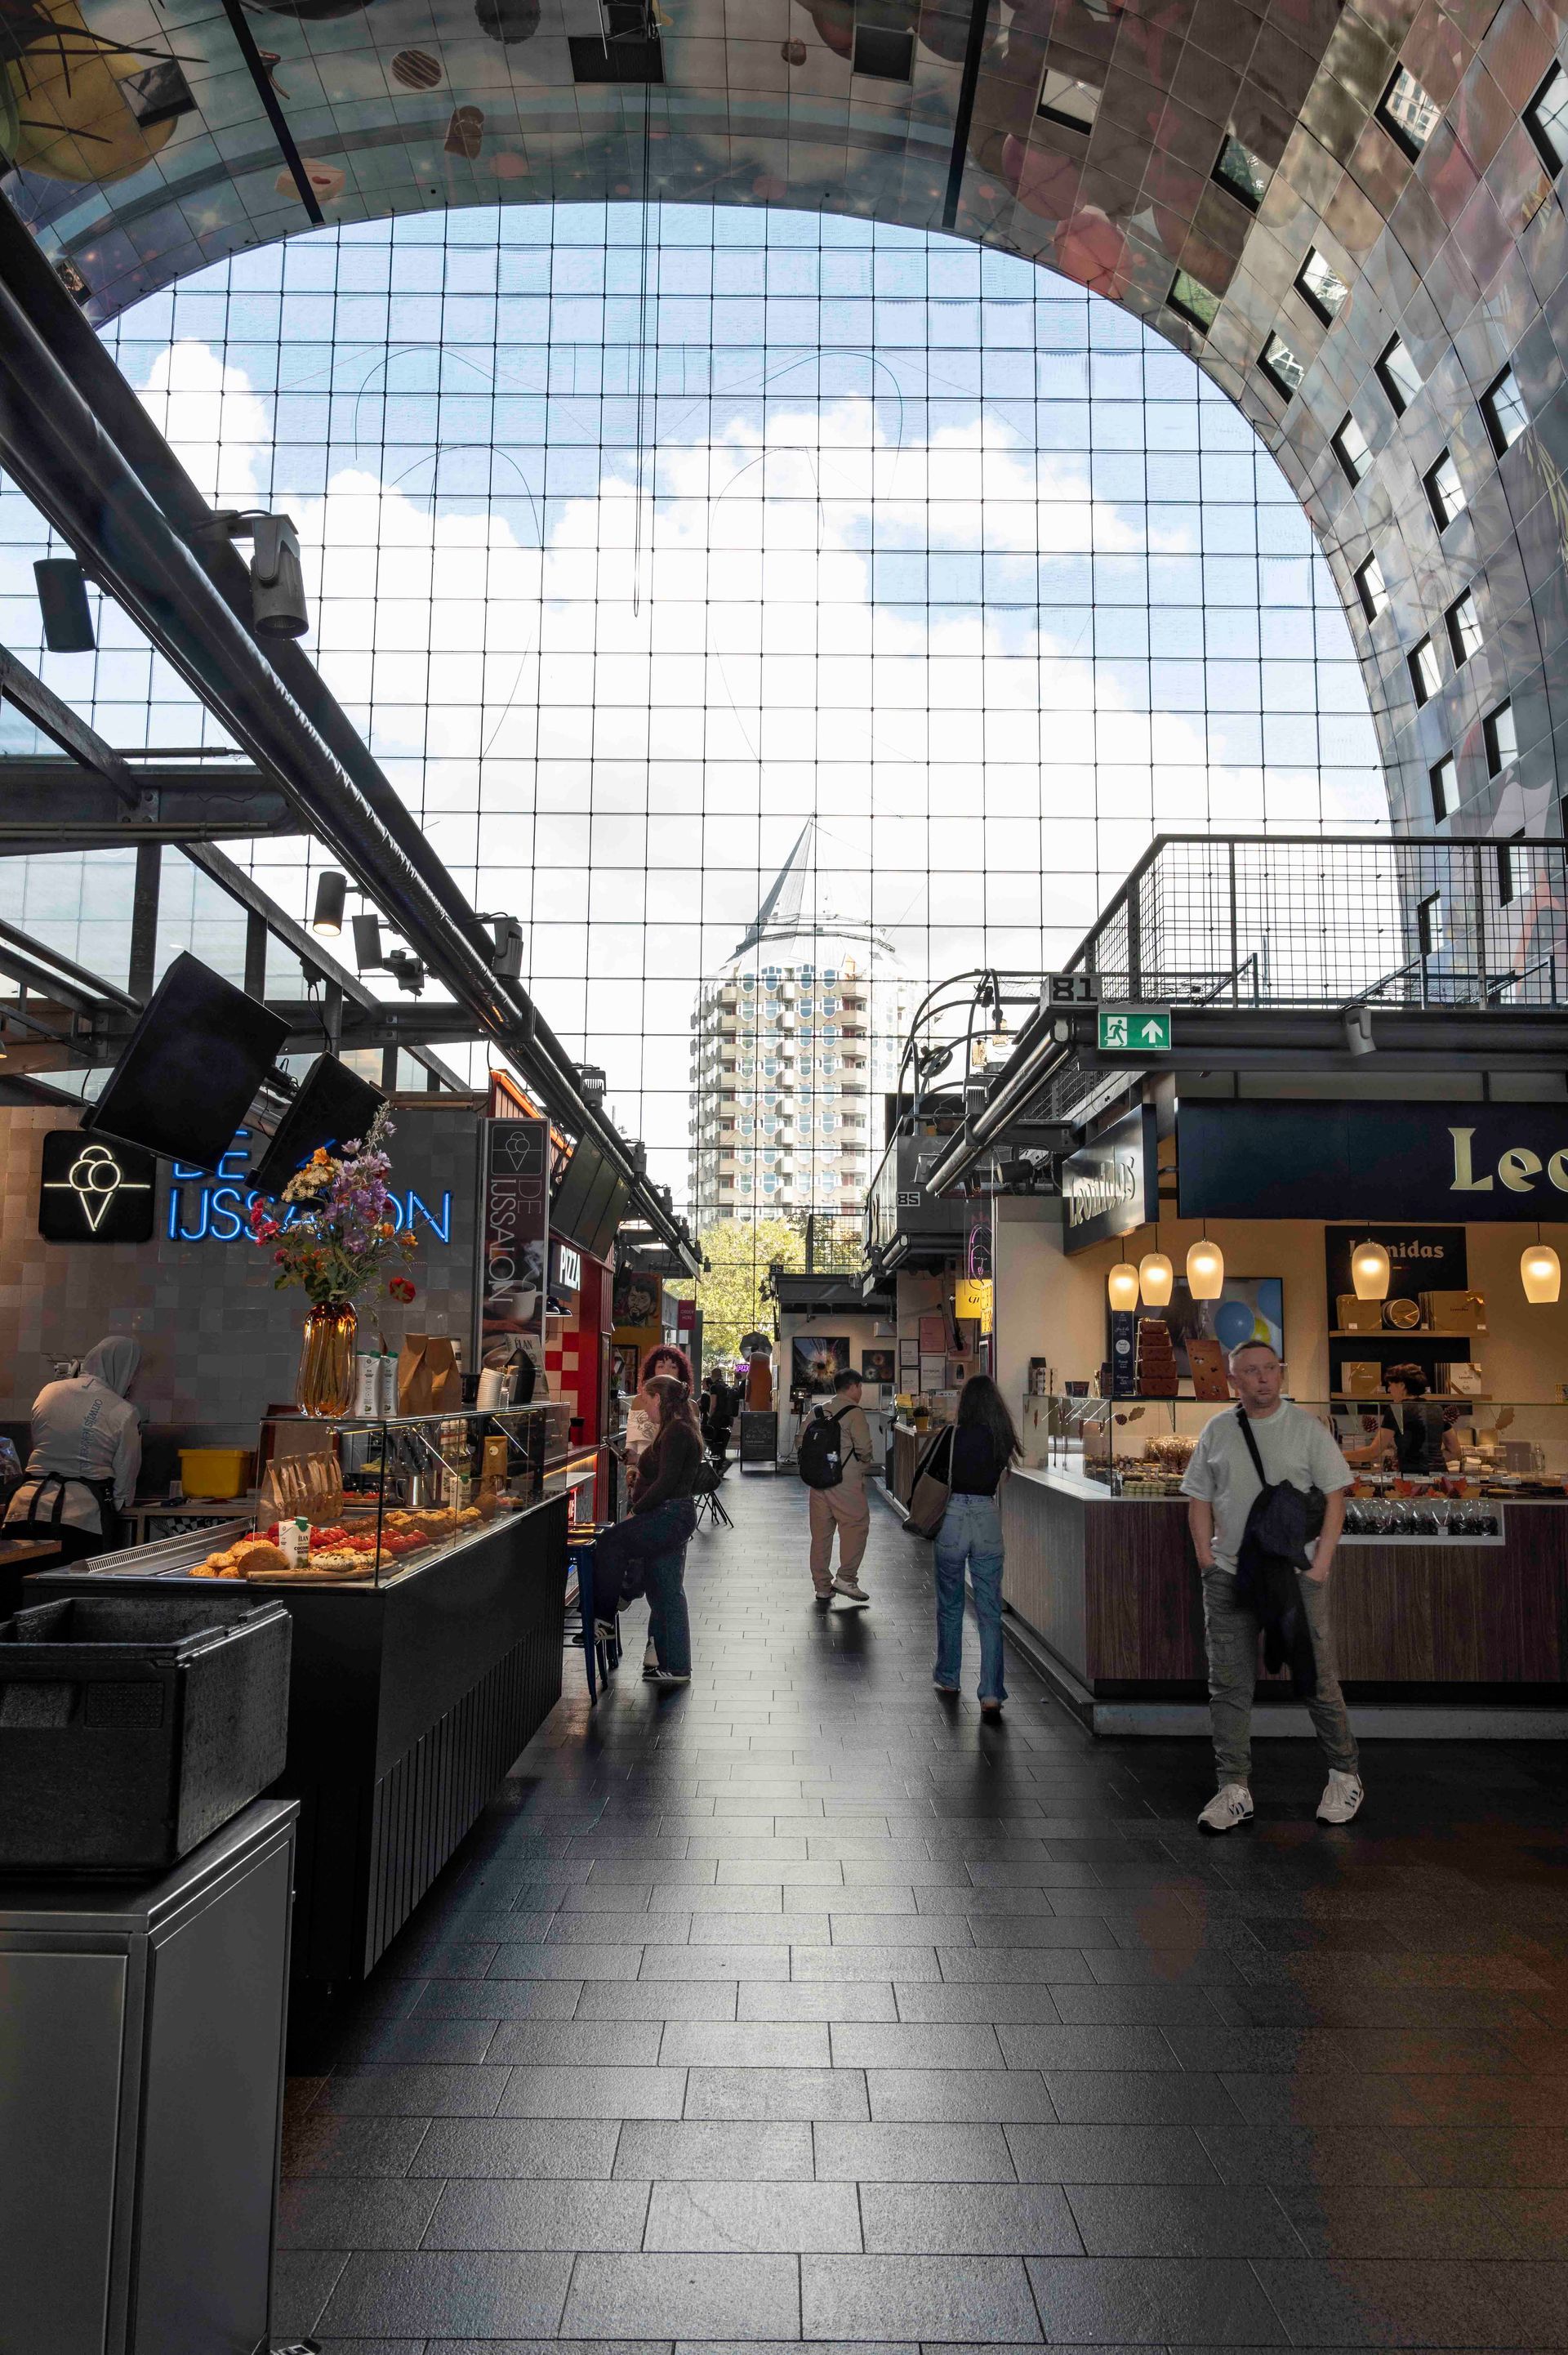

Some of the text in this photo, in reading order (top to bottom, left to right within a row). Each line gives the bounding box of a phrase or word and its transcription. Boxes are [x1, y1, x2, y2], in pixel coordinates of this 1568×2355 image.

[1053, 977, 1098, 1001] 81
[518, 1180, 541, 1214] DE
[898, 1193, 920, 1205] 85
[488, 1178, 517, 1303] IJSSALON
[559, 1244, 581, 1291] PIZZA
